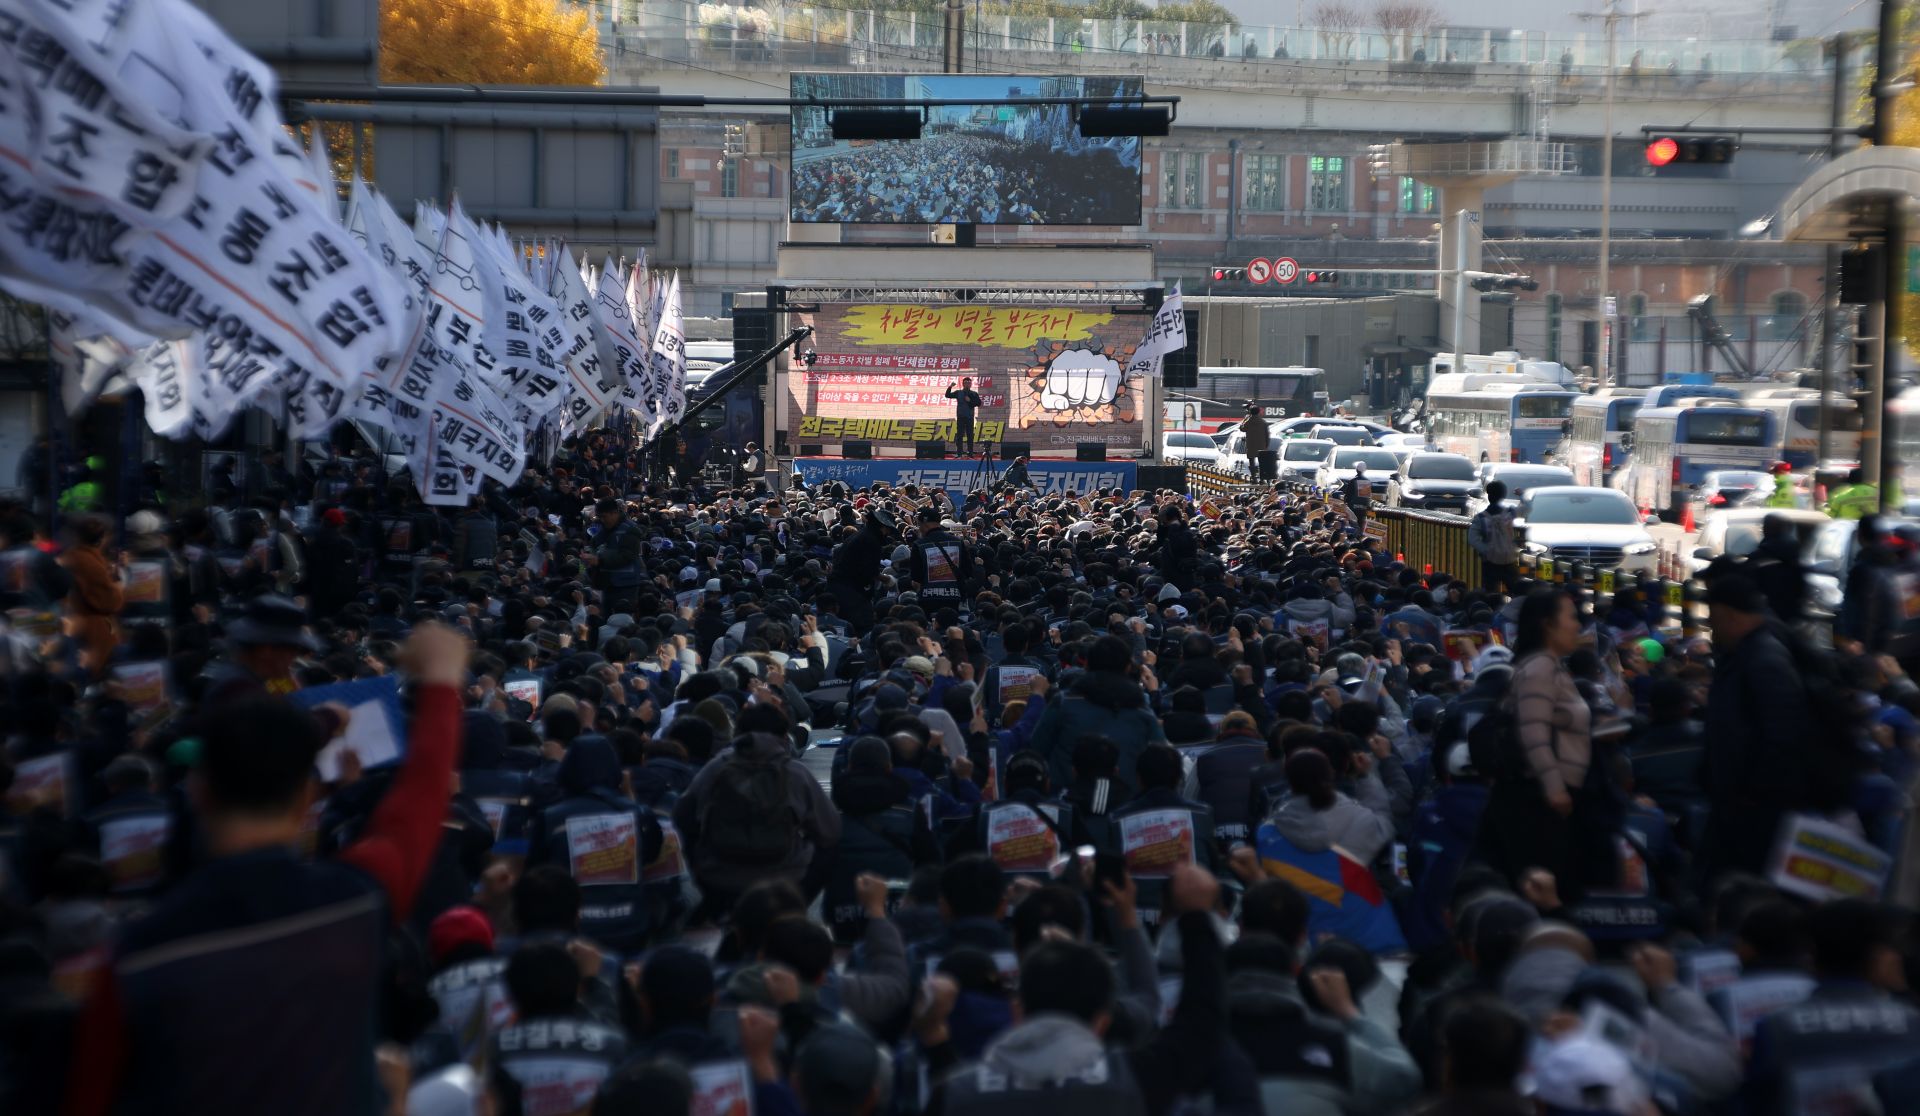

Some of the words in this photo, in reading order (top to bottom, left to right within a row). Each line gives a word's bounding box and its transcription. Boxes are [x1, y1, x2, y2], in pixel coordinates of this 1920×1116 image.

[1278, 263, 1294, 277] 50
[880, 307, 942, 340] 차별의
[954, 309, 997, 343] 벽을
[1005, 309, 1074, 340] 부수자!
[856, 354, 872, 365] 차별
[804, 373, 828, 383] 노조법
[870, 374, 903, 384] 거부하는
[962, 376, 991, 388] 진!”
[861, 393, 869, 403] 수
[1265, 407, 1286, 416] BUS
[844, 463, 869, 477] 부수자!
[896, 470, 1124, 496] 전국택배동자대회
